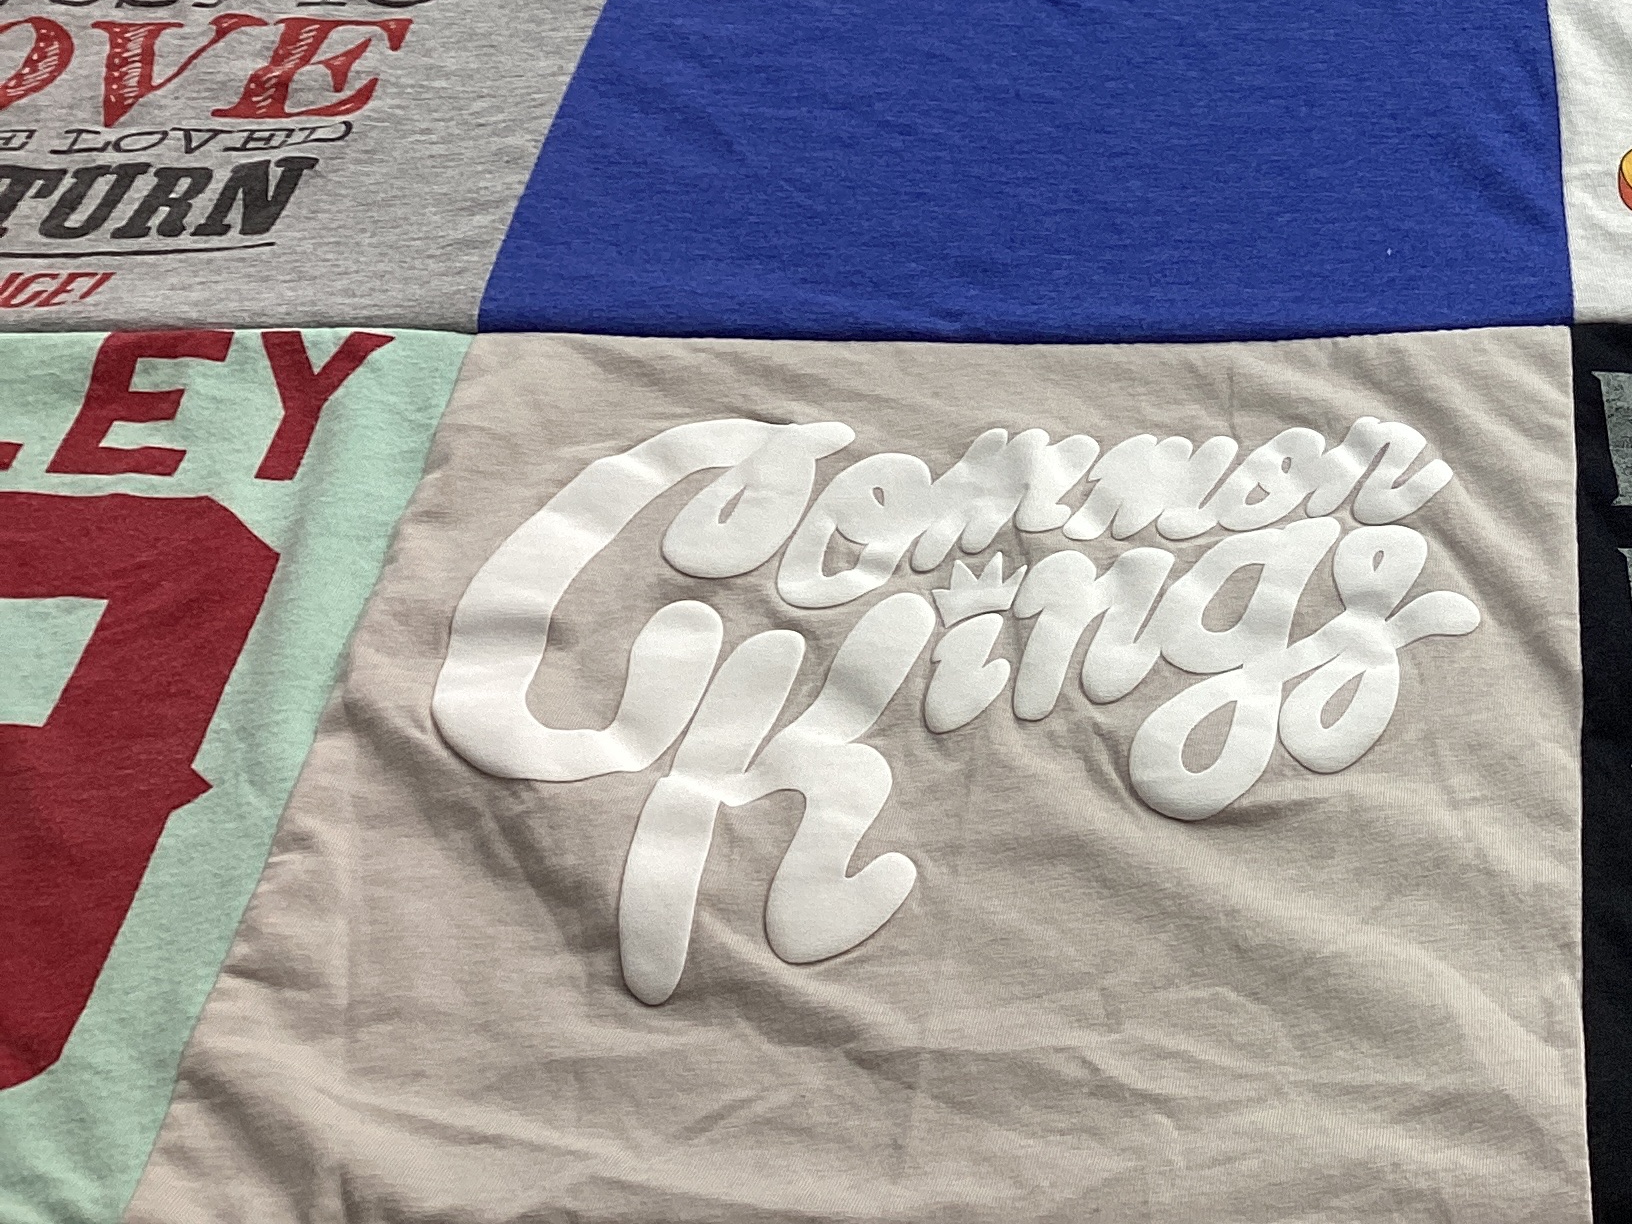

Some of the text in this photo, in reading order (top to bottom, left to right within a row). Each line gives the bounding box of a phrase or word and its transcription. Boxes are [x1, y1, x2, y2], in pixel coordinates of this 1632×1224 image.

[0, 11, 414, 128] OVE
[49, 120, 353, 156] LOVED
[0, 156, 320, 240] TURN
[0, 329, 397, 482] EY
